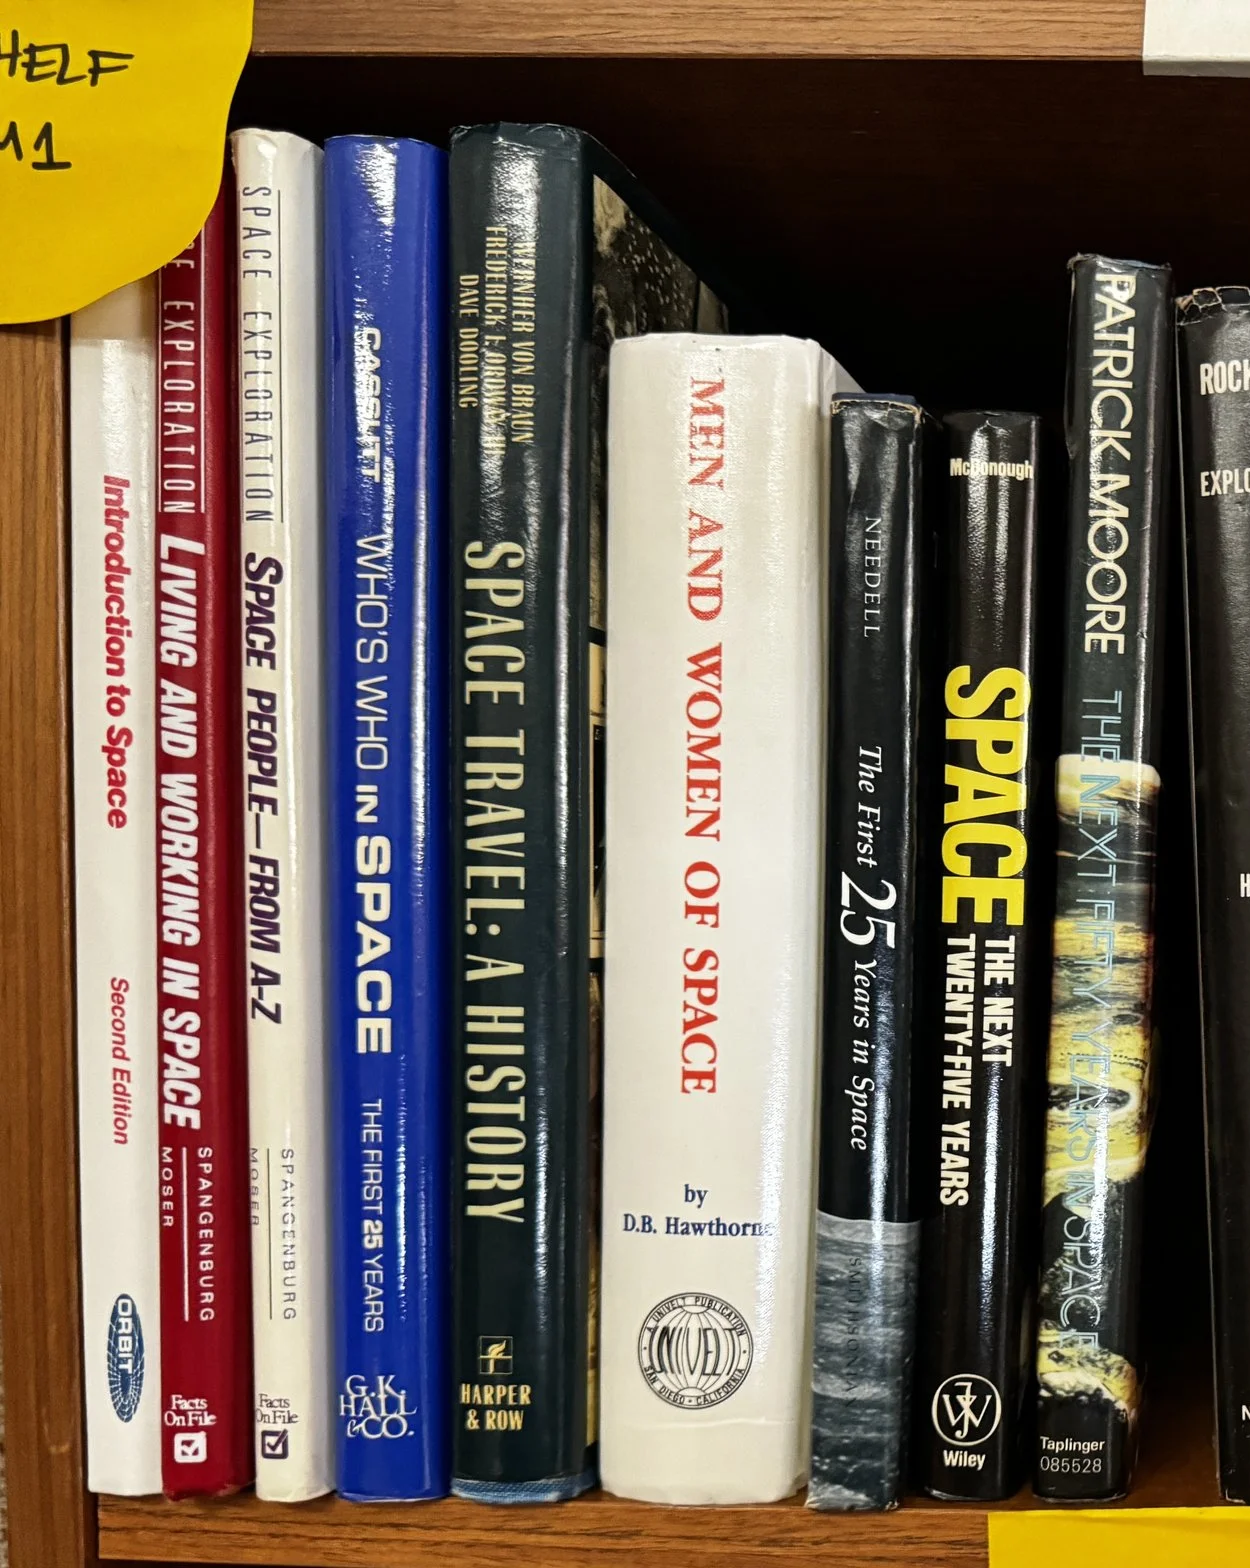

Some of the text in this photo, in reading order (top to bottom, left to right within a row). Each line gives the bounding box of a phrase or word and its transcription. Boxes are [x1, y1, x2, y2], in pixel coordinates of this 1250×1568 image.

[242, 187, 274, 523] SPACE EXPLORATION
[458, 274, 479, 408] DAVE DOOLING
[485, 226, 508, 325] FREDERICK
[511, 242, 536, 443] WERNHER VON BRAUN
[164, 301, 195, 514] EXPLORATION
[950, 457, 1033, 480] McDonough
[1084, 273, 1137, 654] PATRICK MOORE
[101, 475, 133, 829] Introduction to Space
[863, 516, 882, 638] NEEDELL
[244, 552, 283, 1024] SPACE A-Z
[355, 534, 392, 1054] WHO'S WHO IN SPACE
[680, 376, 725, 1094] MEN AND WOMEN OF SPACE
[941, 665, 1031, 925] SPACE
[160, 533, 205, 1129] LIVING AND WORKING IN SPACE
[464, 541, 526, 1223] SPACE TRAVEL: A HISTORY
[1073, 690, 1122, 1009] THE NEXT FIFTY
[840, 746, 897, 1151] The First 25 Years in Space
[982, 935, 1016, 1067] THE NEXT
[110, 977, 132, 1145] Second Edition
[940, 934, 976, 1206] TWENTY-FIVE YEARS
[162, 1147, 174, 1228] MOSER
[198, 1146, 214, 1322] SPANGENBURG
[281, 1148, 297, 1320] SPANGENBURG
[361, 1099, 384, 1332] THE FIRST 25 YEARS
[623, 1214, 657, 1233] D.B.
[684, 1184, 707, 1208] by
[460, 1384, 531, 1405] HARPER
[695, 1296, 748, 1337] PUBLICATION
[696, 1369, 746, 1405] CALIFORNIA
[171, 1394, 208, 1410] Facts
[466, 1410, 524, 1430] & ROW
[943, 1450, 986, 1471] Wiley
[1040, 1436, 1105, 1453] Taplinger
[1040, 1457, 1102, 1473] 085528
